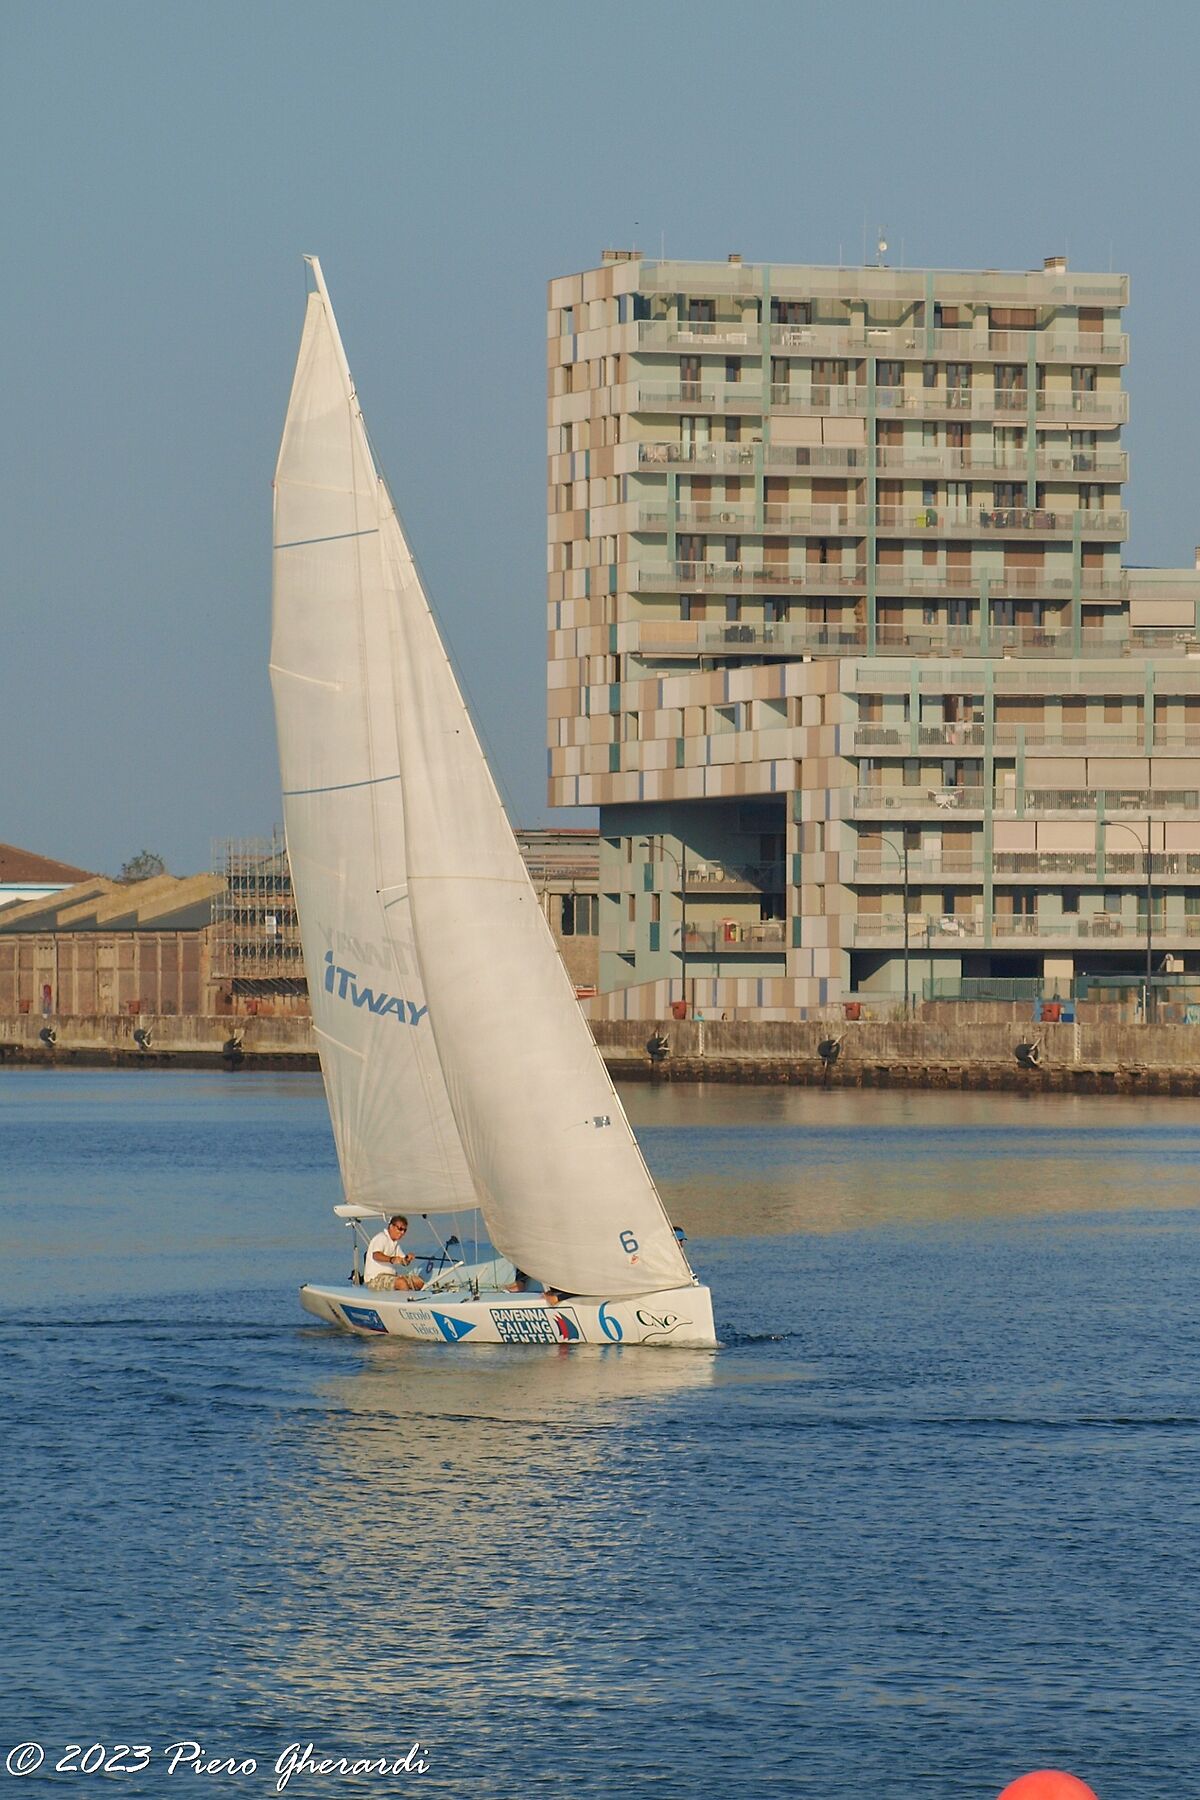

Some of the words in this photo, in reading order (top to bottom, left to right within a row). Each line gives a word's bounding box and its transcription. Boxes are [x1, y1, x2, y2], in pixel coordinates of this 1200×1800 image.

[620, 1230, 639, 1254] 6
[491, 1309, 547, 1322] RAVENNA
[598, 1300, 624, 1342] 6
[497, 1320, 553, 1334] SAILING
